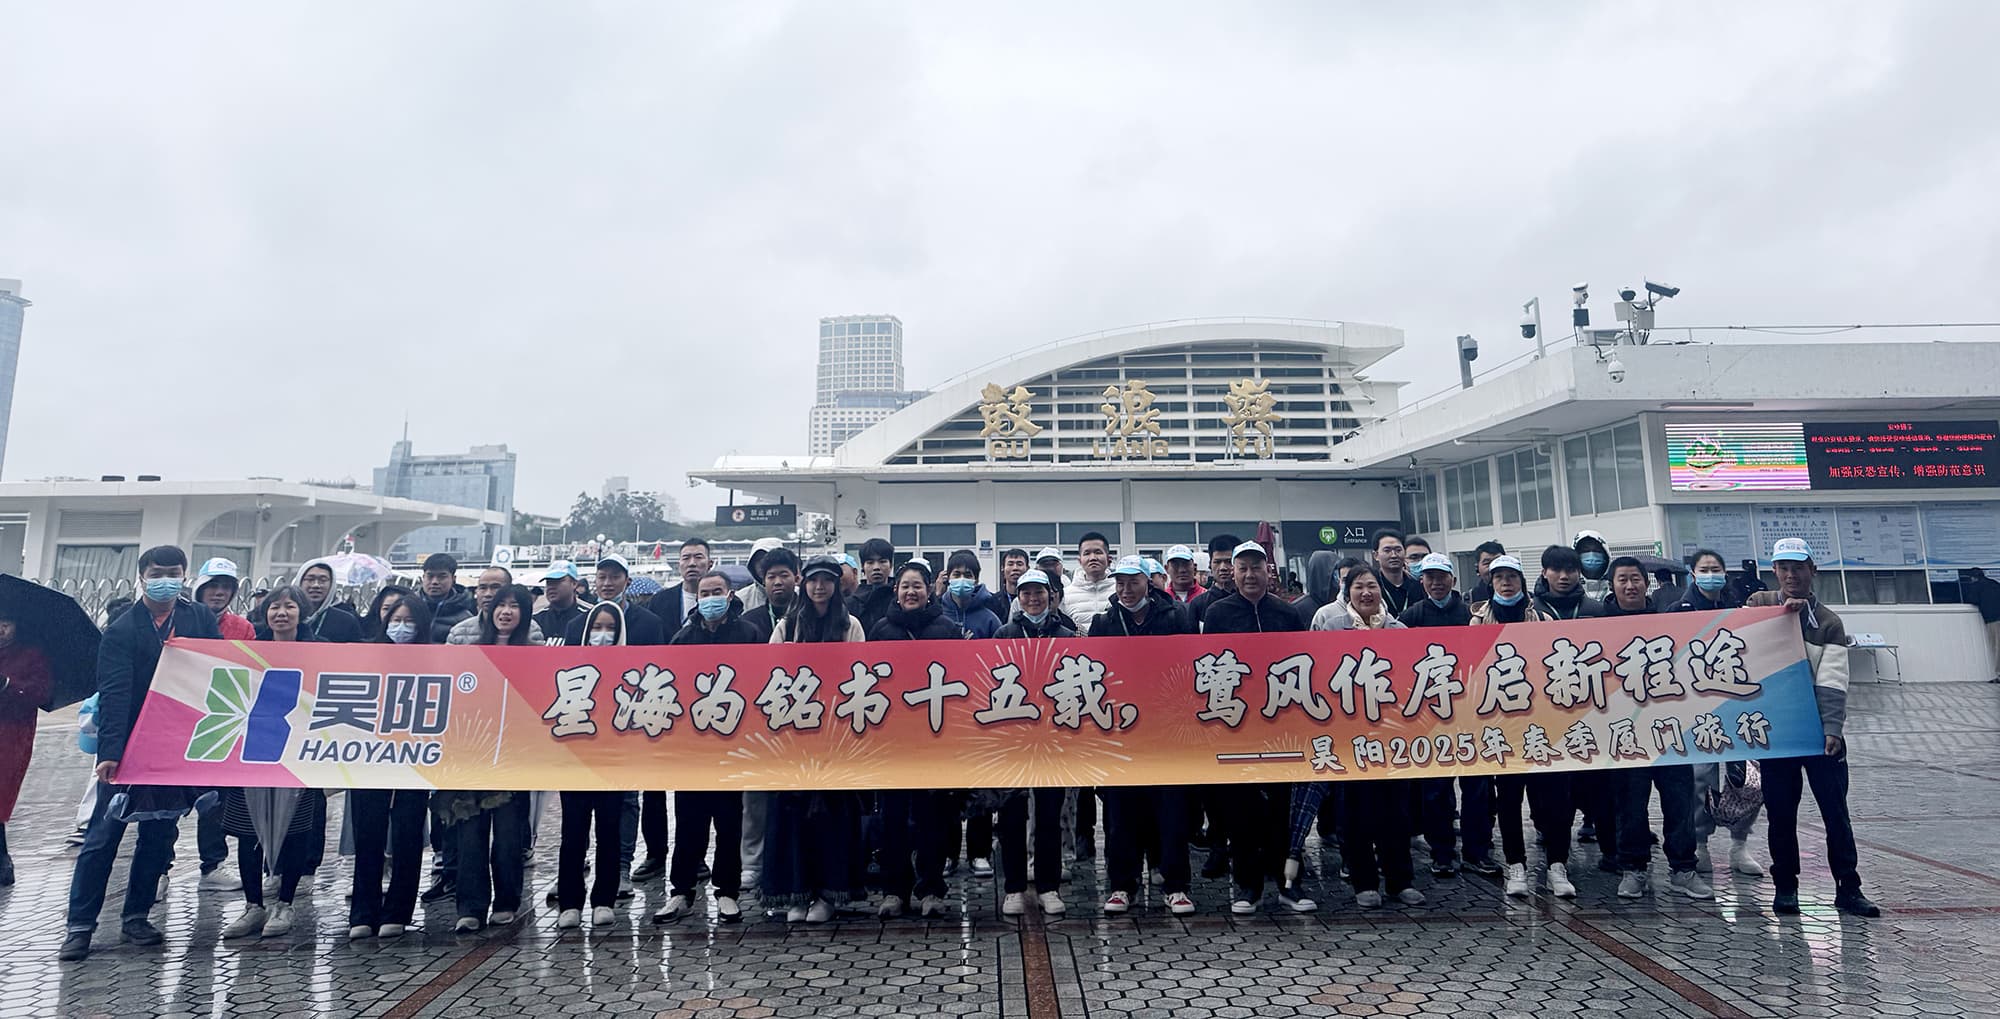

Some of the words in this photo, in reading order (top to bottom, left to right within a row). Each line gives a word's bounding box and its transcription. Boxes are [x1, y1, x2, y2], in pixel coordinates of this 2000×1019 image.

[989, 439, 1029, 458] GU
[1093, 439, 1169, 458] LANG
[1234, 438, 1273, 458] YU
[751, 508, 780, 516] 禁止通行
[1344, 526, 1365, 537] 入口
[309, 673, 452, 736] 昊阳
[299, 739, 443, 764] HAOYANG
